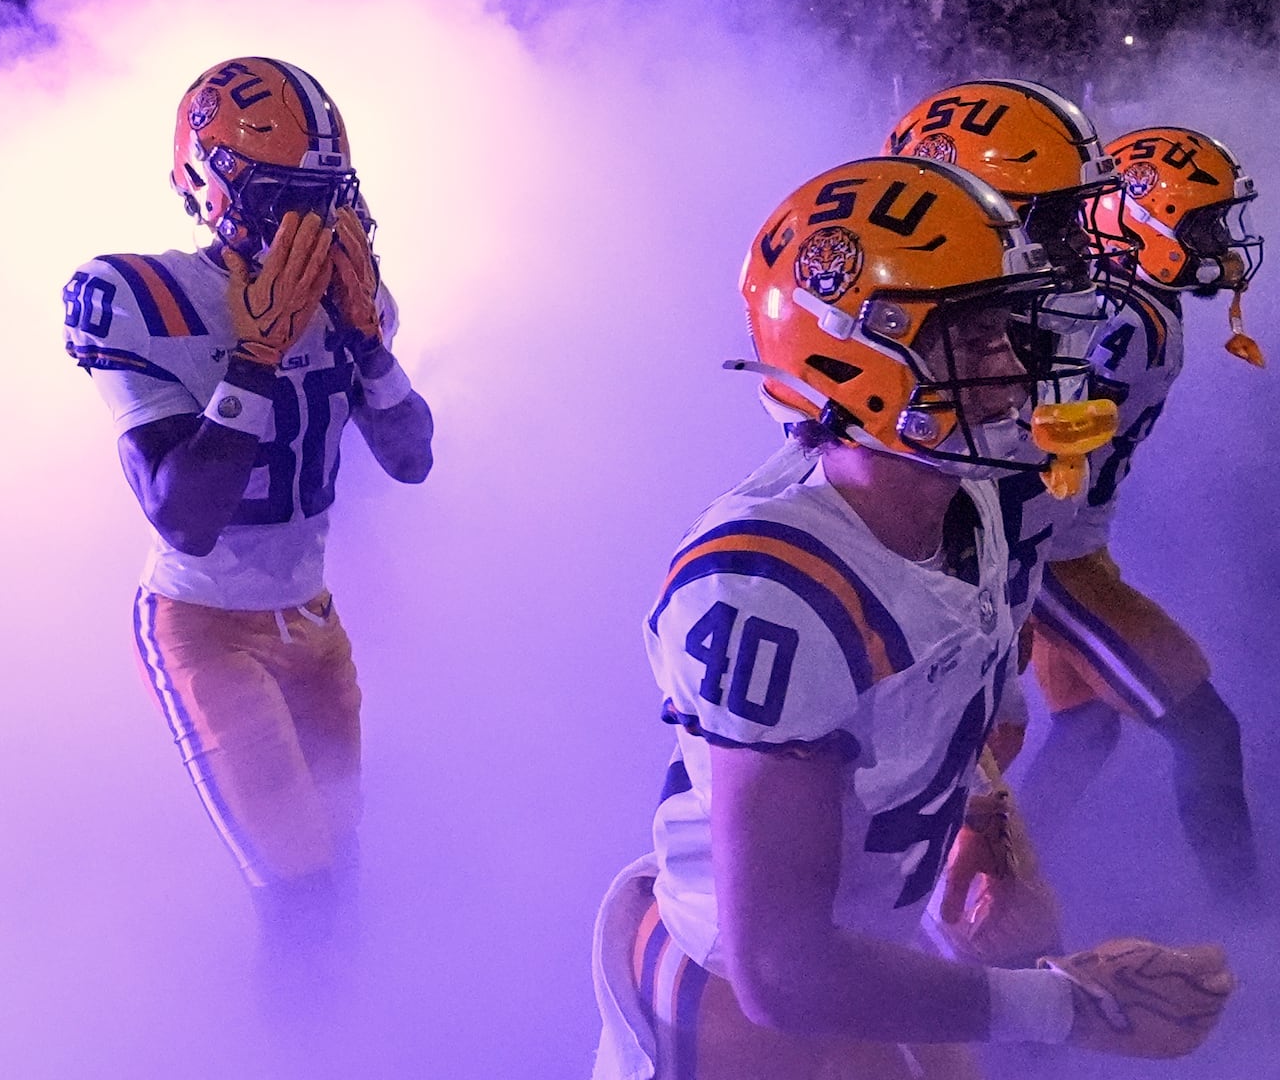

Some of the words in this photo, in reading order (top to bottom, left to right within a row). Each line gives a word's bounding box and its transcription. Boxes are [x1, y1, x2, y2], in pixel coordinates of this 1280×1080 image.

[760, 178, 938, 270] LSU
[62, 271, 117, 339] 80
[685, 600, 800, 727] 40
